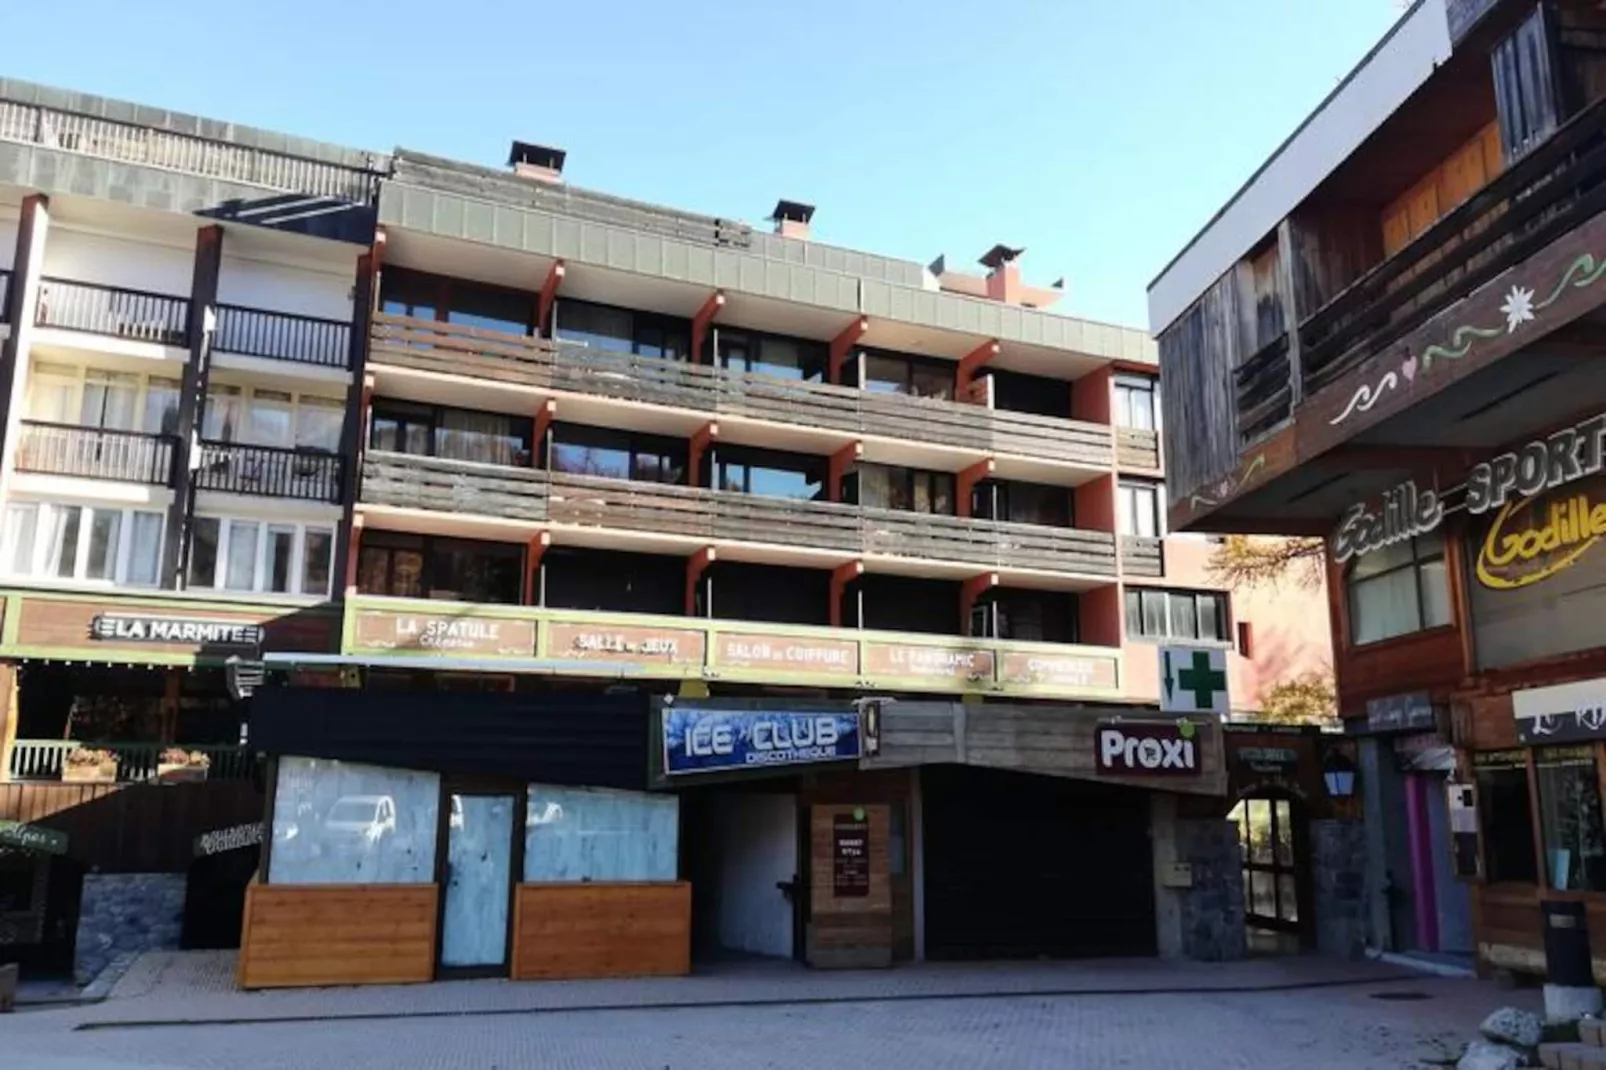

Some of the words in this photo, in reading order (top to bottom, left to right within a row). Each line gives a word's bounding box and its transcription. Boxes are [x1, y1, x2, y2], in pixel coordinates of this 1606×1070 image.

[1334, 479, 1444, 564] Godille
[1485, 496, 1606, 565] Godille
[115, 620, 145, 637] LA
[149, 620, 243, 642] MARMITE
[396, 618, 417, 634] LA
[427, 620, 500, 639] SPATULE
[726, 641, 771, 659] SALON
[785, 645, 849, 664] COIFFURE
[685, 716, 733, 757] ICE
[752, 717, 838, 750] CLUB
[1100, 720, 1195, 768] Proxi
